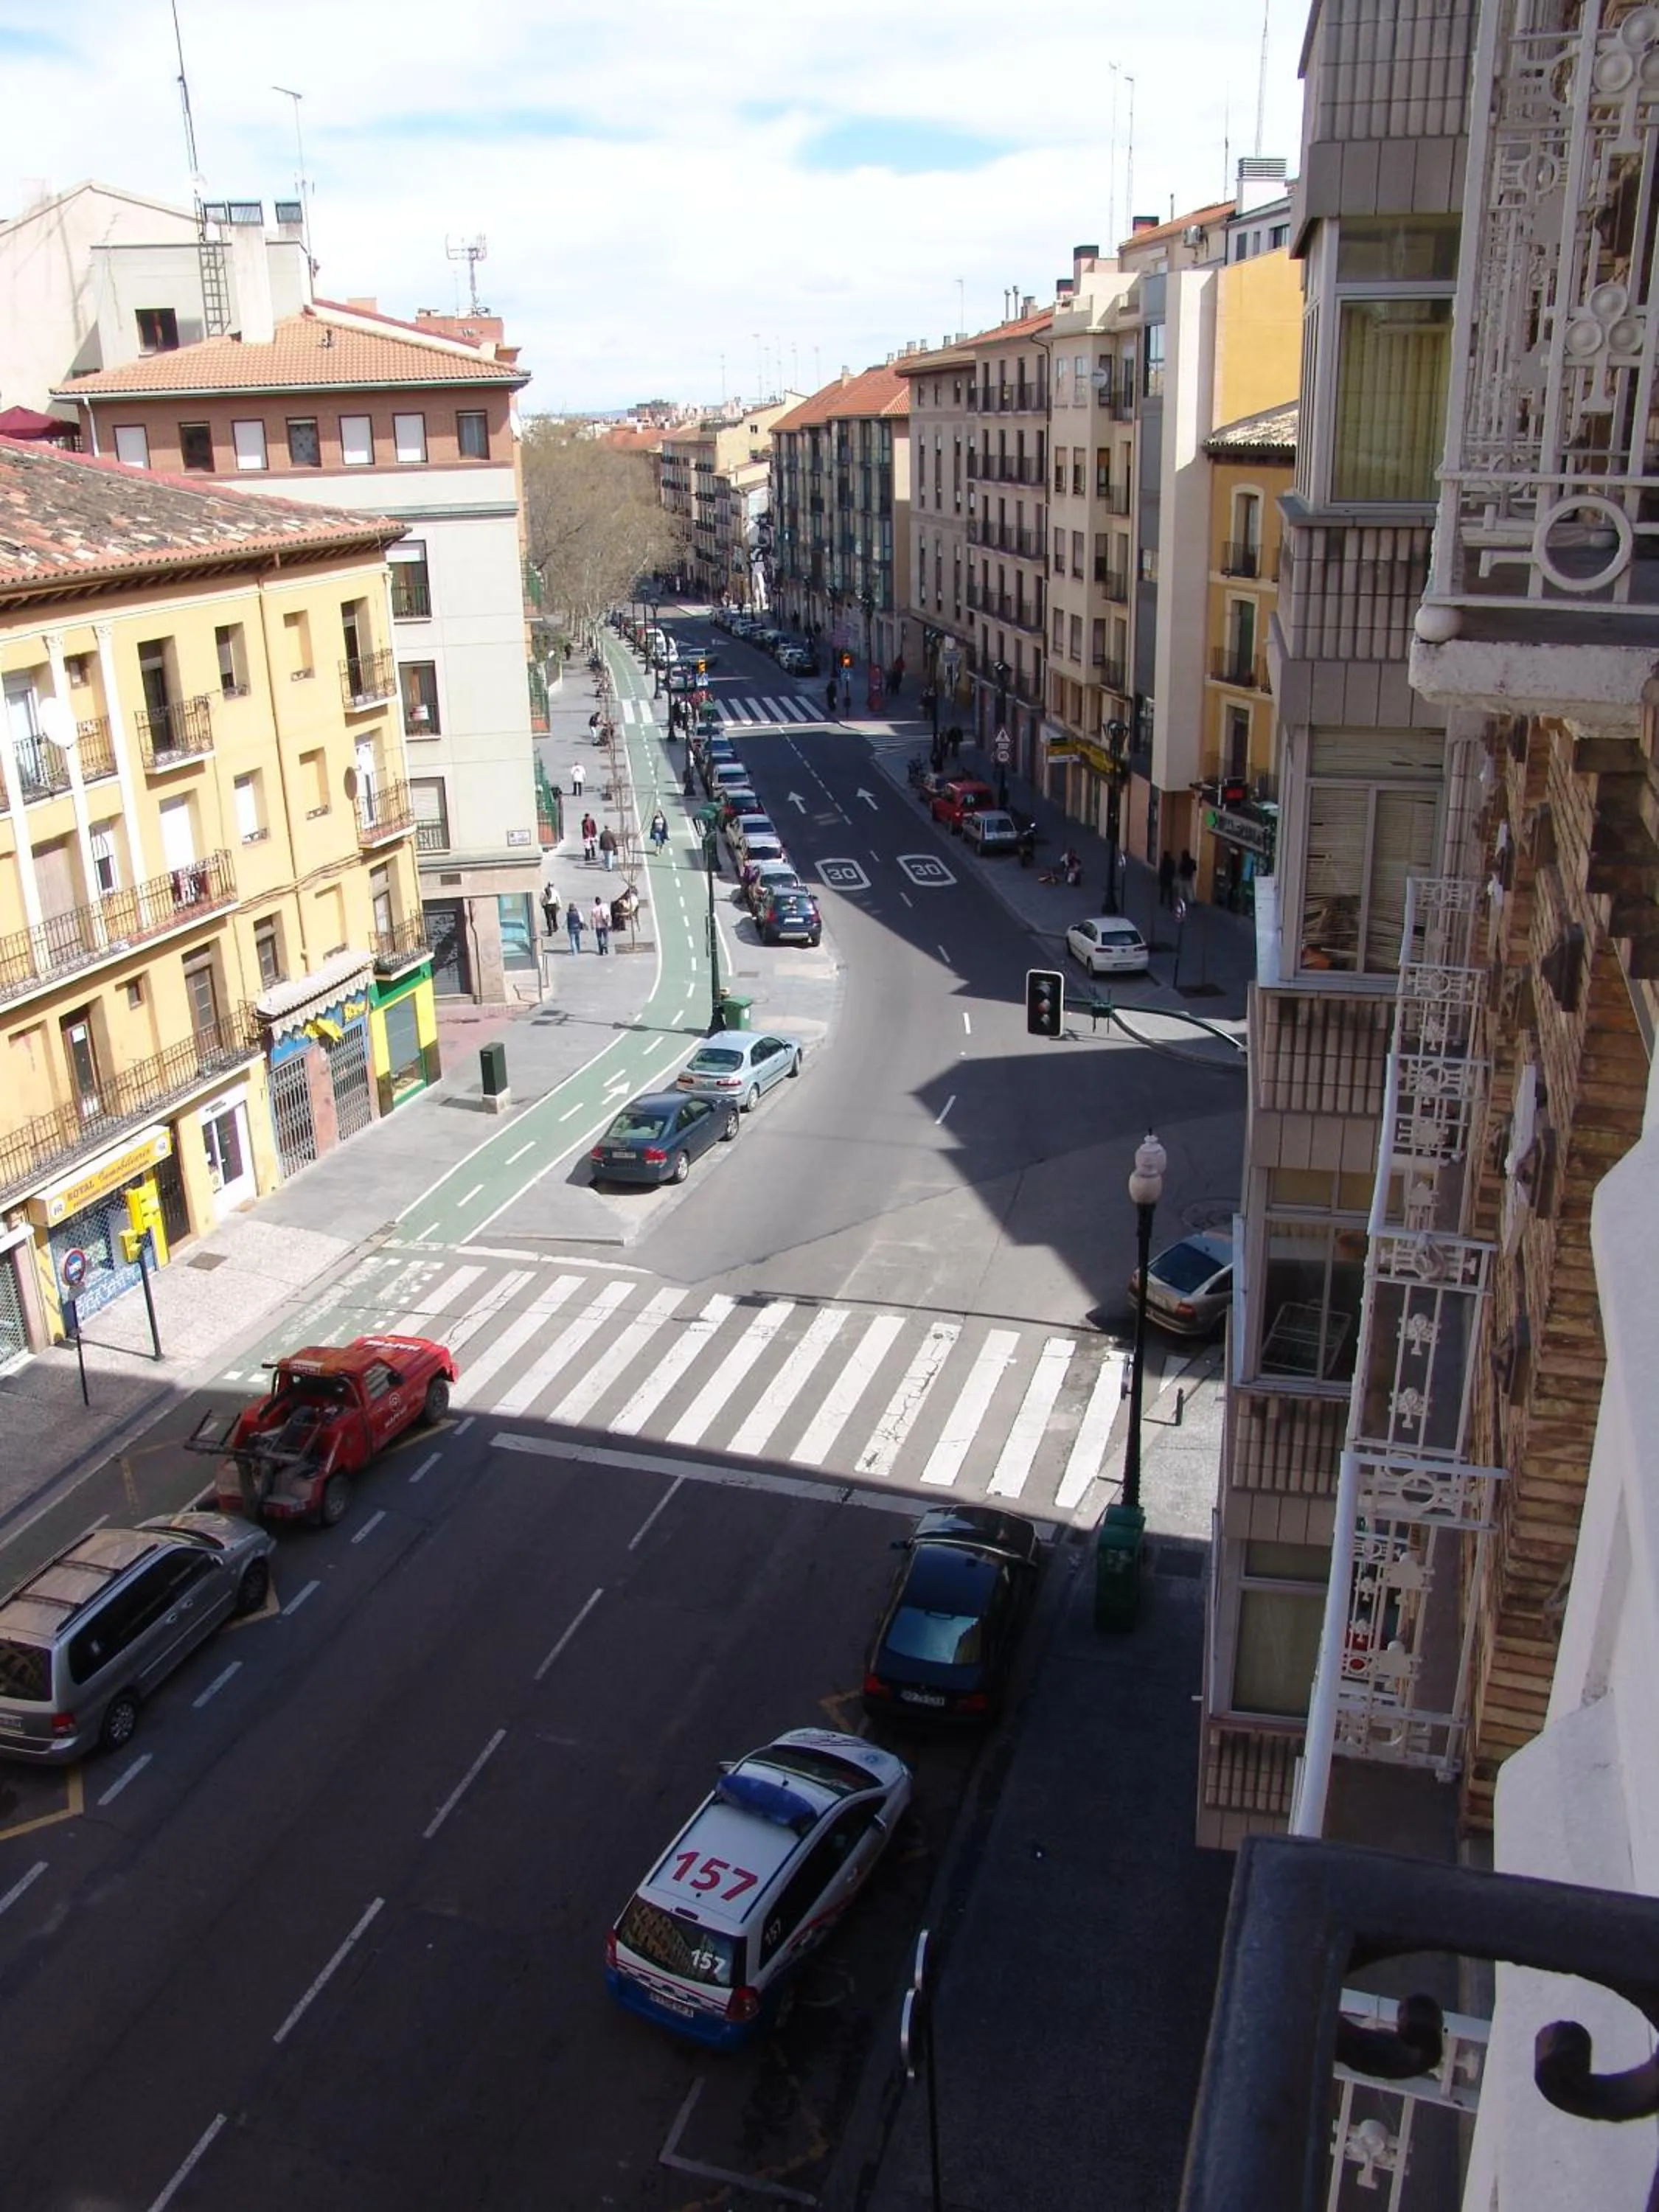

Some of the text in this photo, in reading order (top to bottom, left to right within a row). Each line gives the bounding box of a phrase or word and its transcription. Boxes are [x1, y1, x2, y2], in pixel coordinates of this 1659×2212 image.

[827, 868, 858, 880] 30
[911, 863, 942, 875] 30
[672, 1851, 758, 1902] 157
[764, 1917, 782, 1946] 157
[691, 1949, 726, 1974] 157
